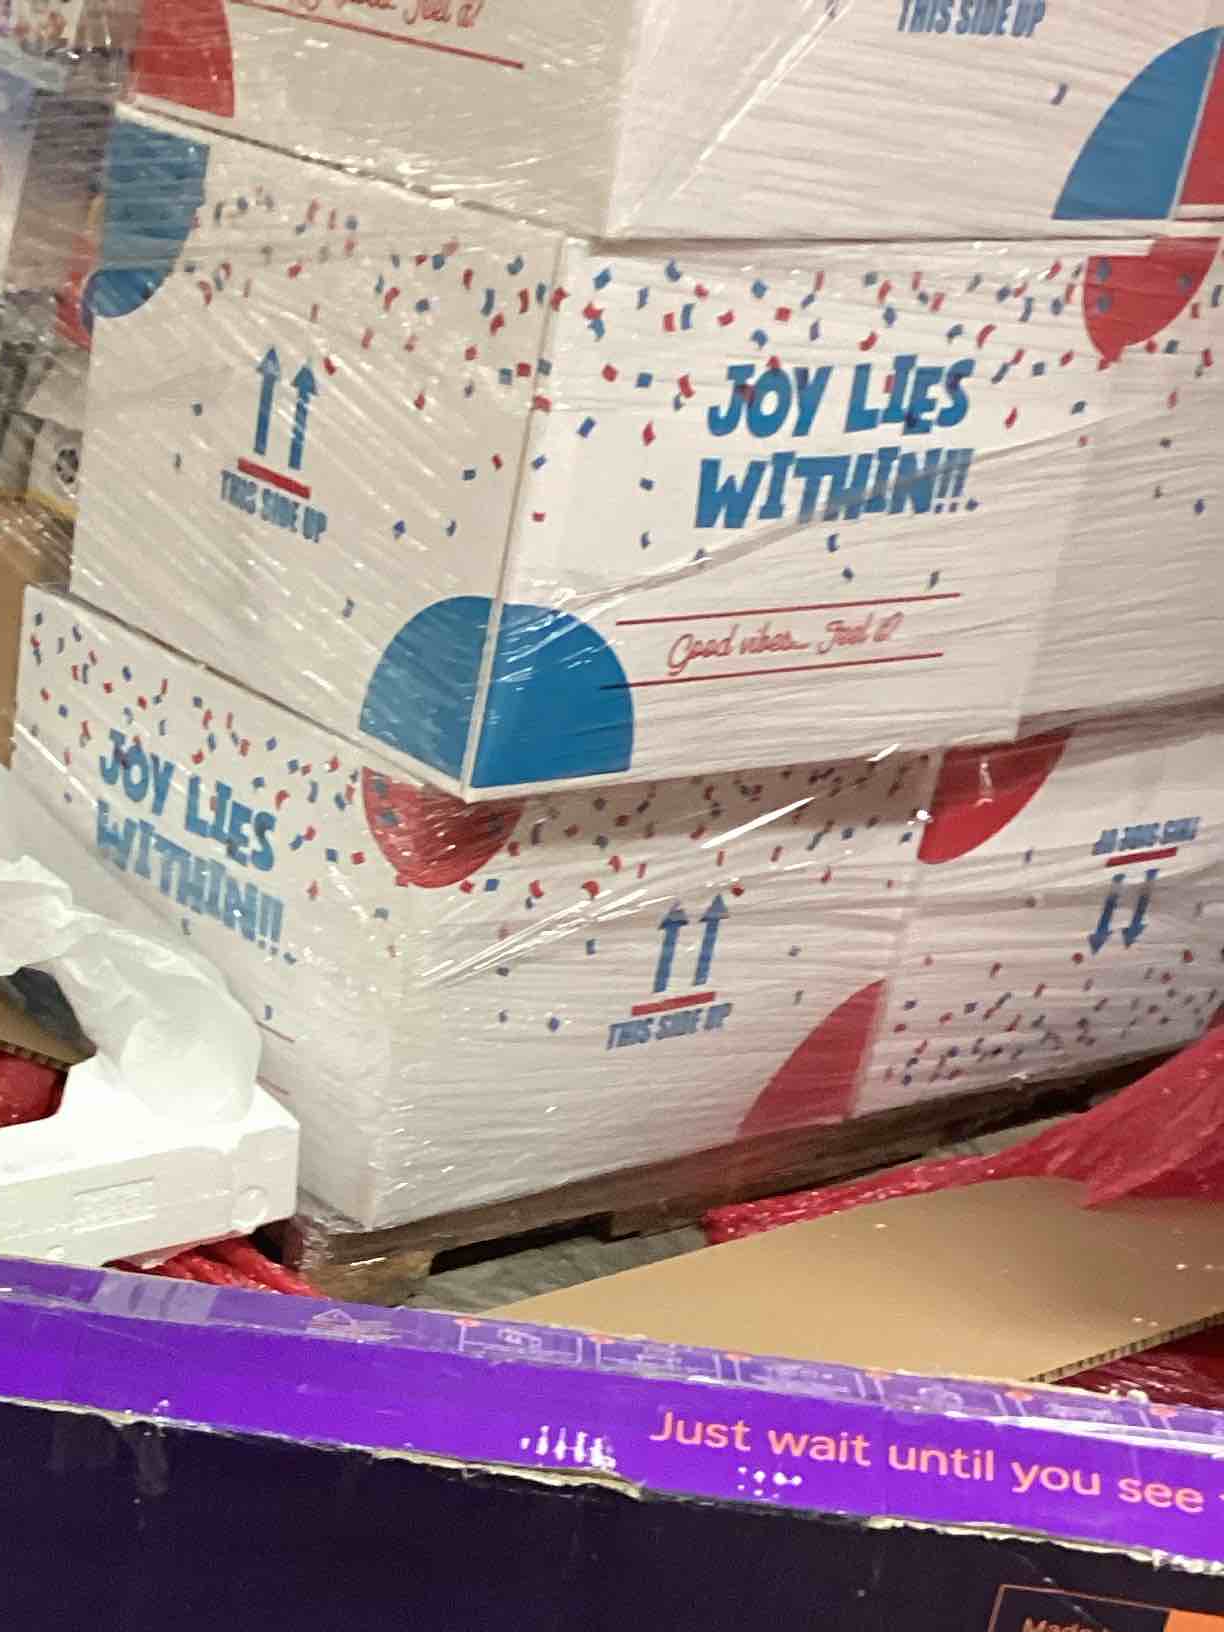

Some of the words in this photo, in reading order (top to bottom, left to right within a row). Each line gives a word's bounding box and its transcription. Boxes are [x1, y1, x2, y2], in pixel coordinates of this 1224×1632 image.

[707, 363, 834, 438] JOY
[844, 354, 976, 434] LIES
[694, 447, 976, 530] WITHIN!!
[98, 728, 174, 816] JOY
[184, 776, 277, 872] LIES
[95, 800, 284, 957] WITHIN!!
[649, 1409, 752, 1452] Just
[767, 1427, 872, 1468] wait
[887, 1442, 996, 1482] until
[1010, 1460, 1101, 1495] you
[1117, 1476, 1205, 1514] see
